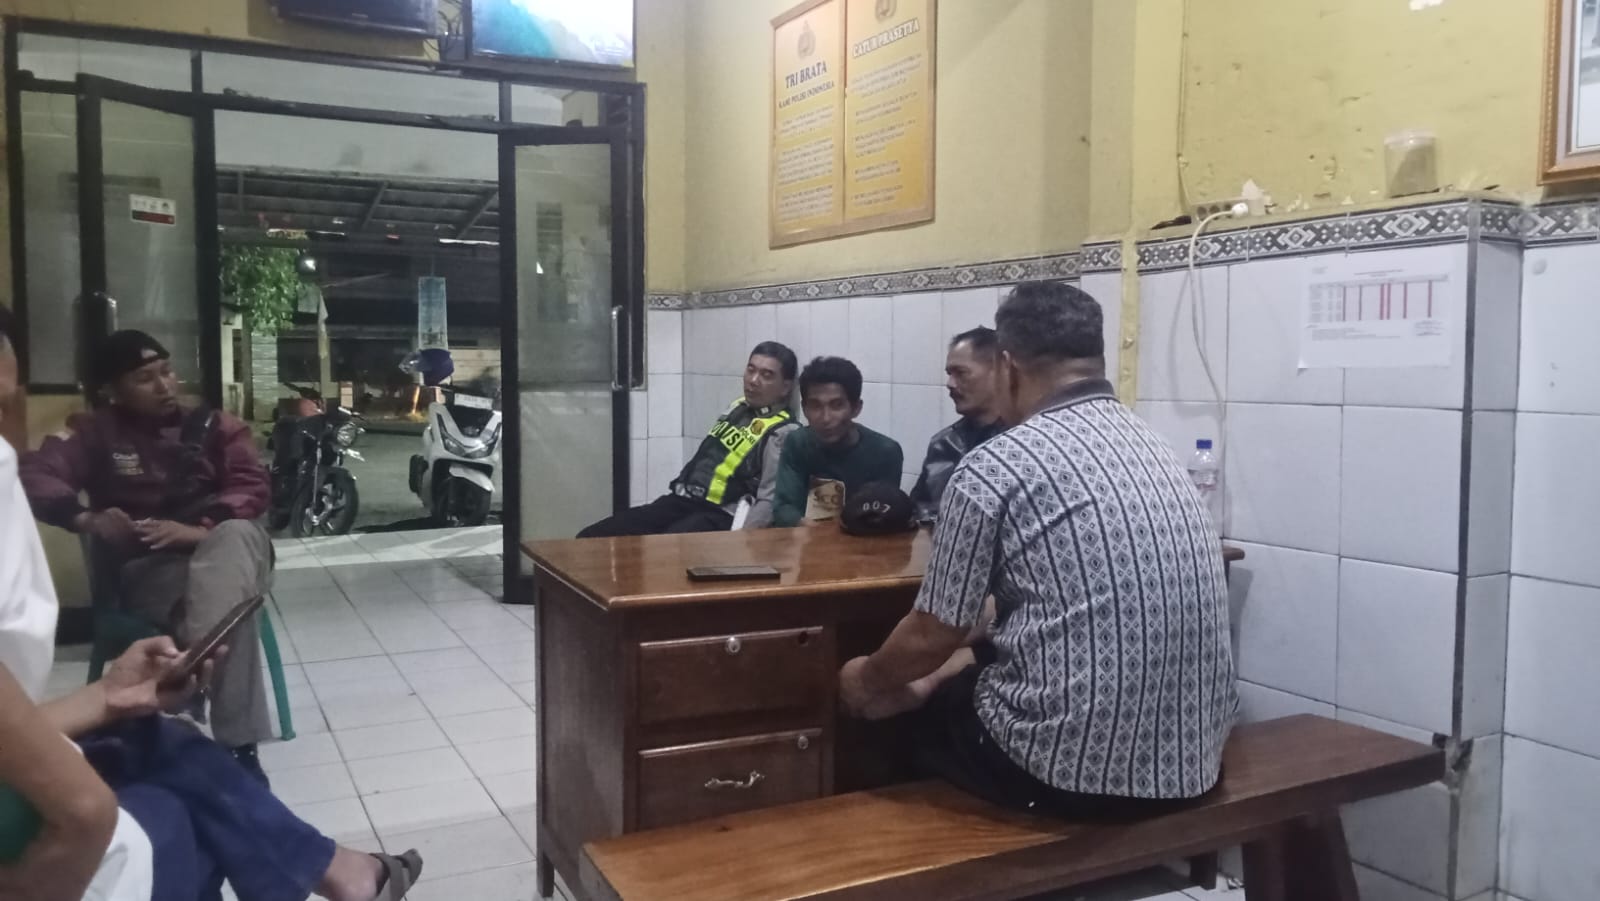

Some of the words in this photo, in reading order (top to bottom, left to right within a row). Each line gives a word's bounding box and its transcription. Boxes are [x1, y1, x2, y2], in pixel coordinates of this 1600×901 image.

[785, 71, 798, 89] TRI
[800, 61, 827, 83] BRATA
[862, 500, 891, 513] 007
